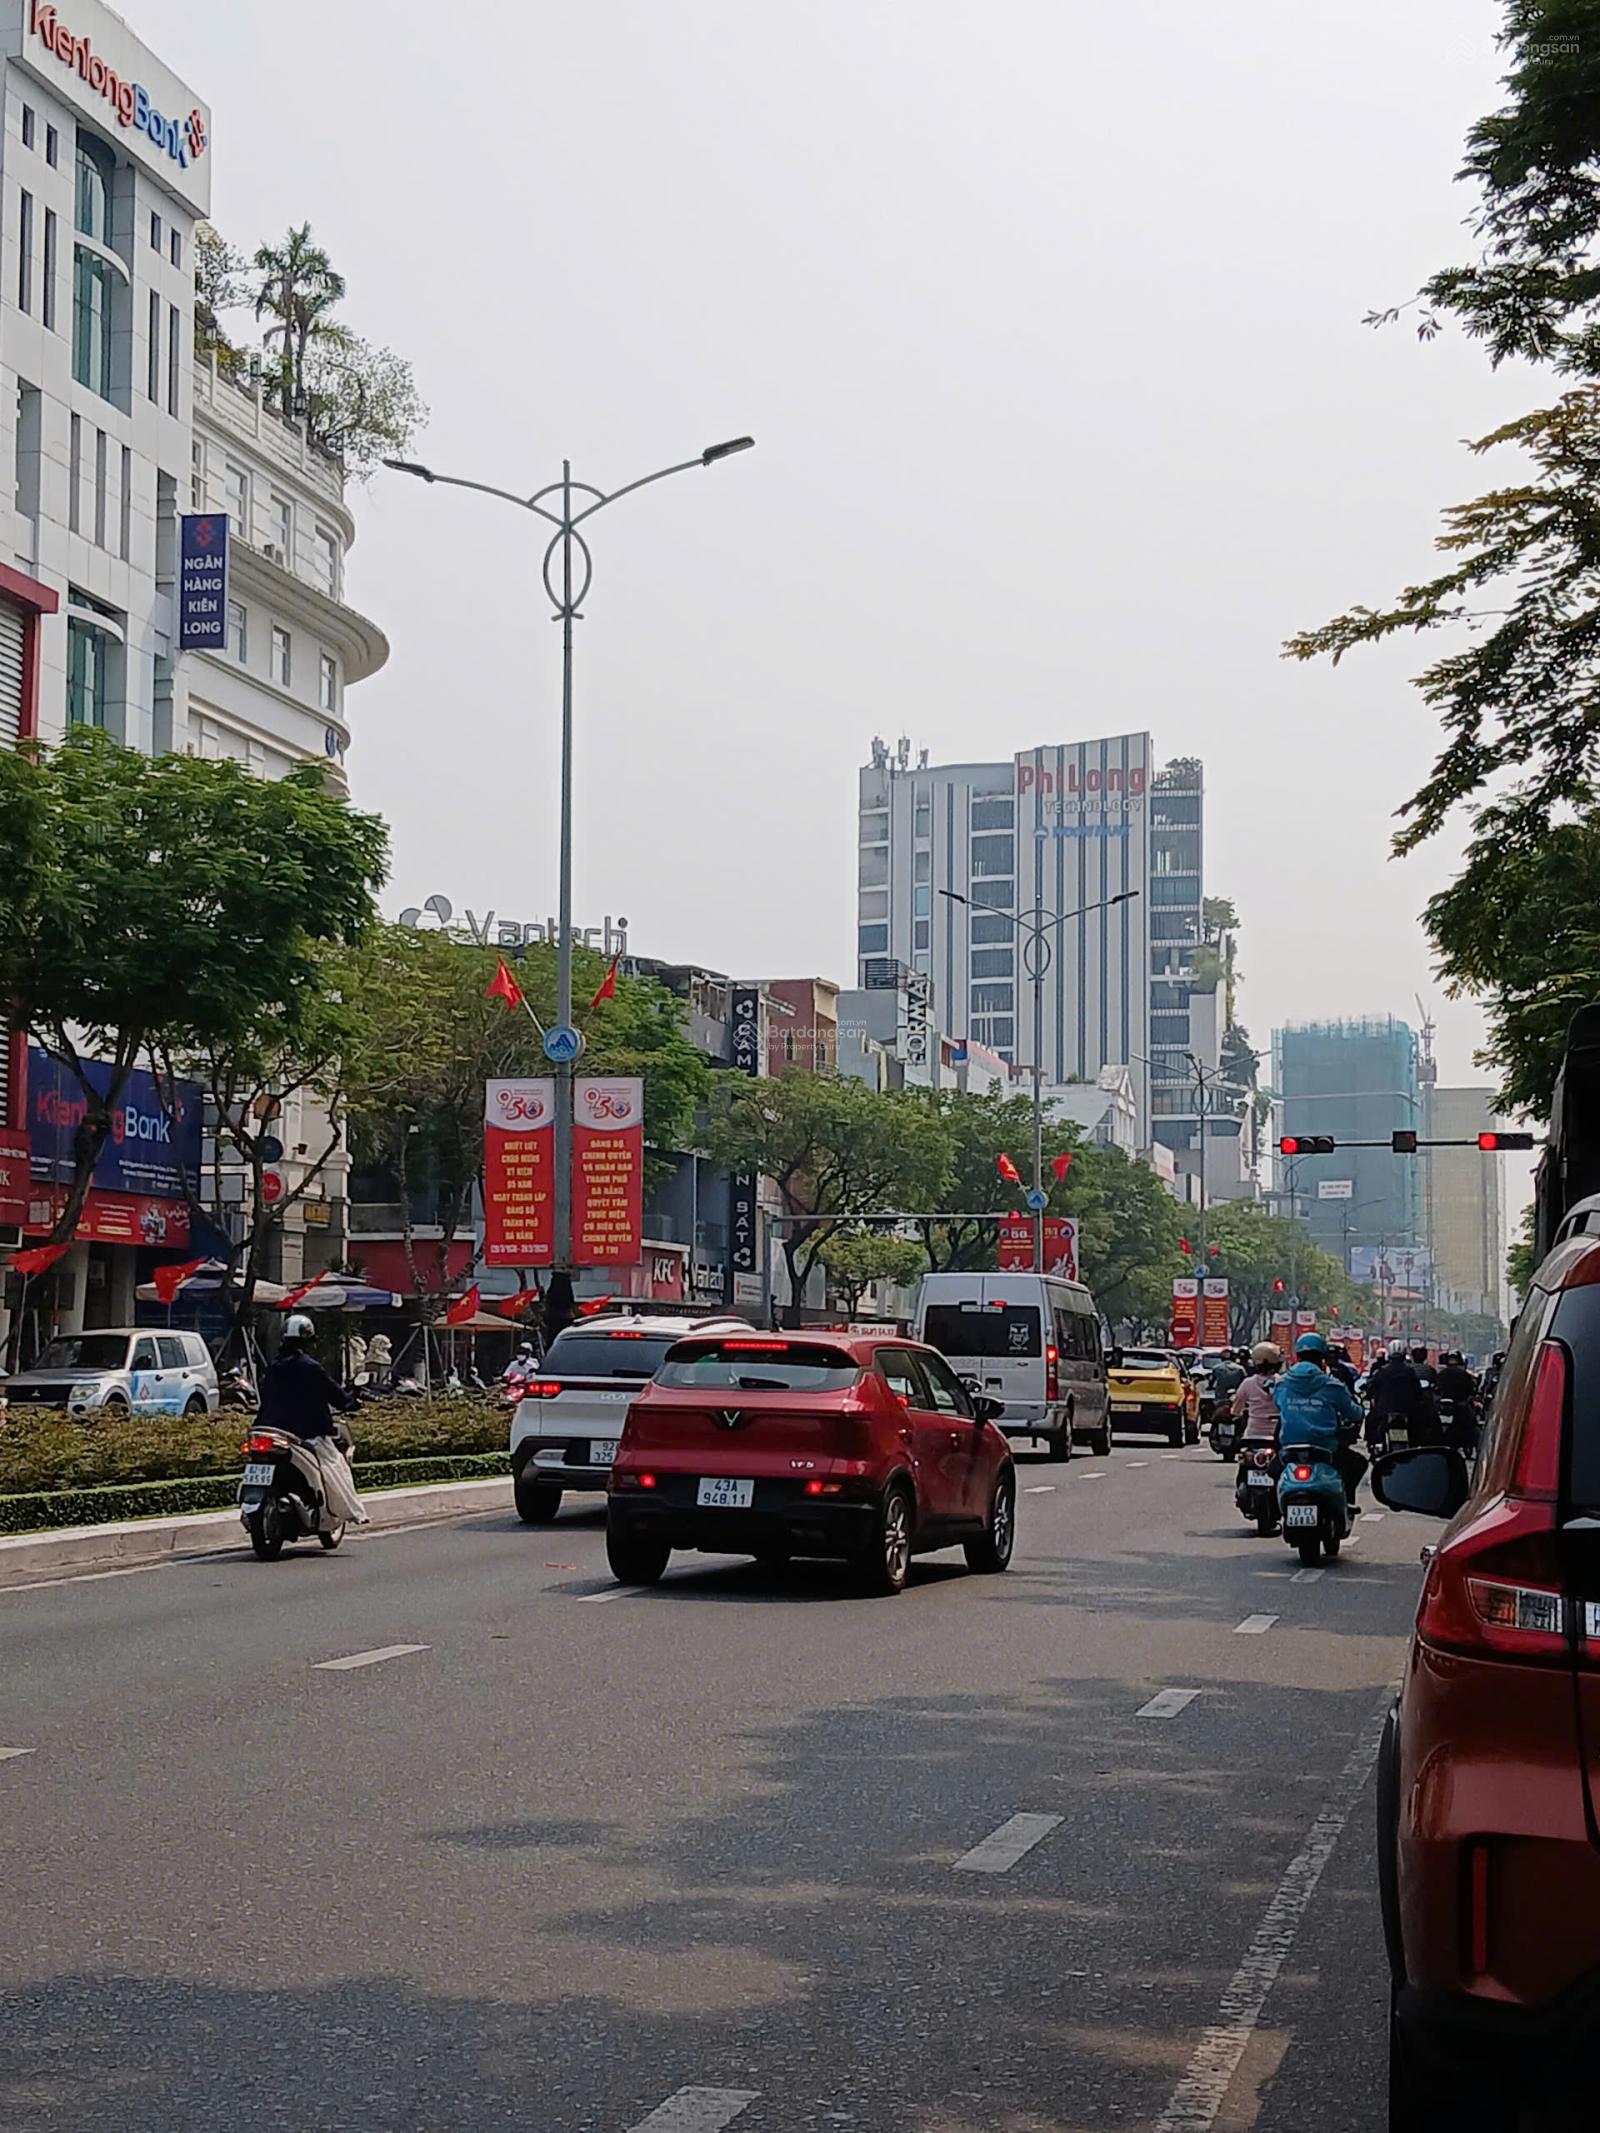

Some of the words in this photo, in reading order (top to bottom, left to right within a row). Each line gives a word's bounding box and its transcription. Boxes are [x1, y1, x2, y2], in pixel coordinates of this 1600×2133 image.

[184, 554, 223, 570] NGÂN
[184, 577, 223, 592] HÀNG
[188, 598, 217, 613] KIÊN
[183, 621, 221, 635] LONG
[736, 1201, 749, 1244] SÁT
[653, 1257, 675, 1283] KFC
[714, 1480, 738, 1492] 43A
[703, 1492, 746, 1506] 948.11
